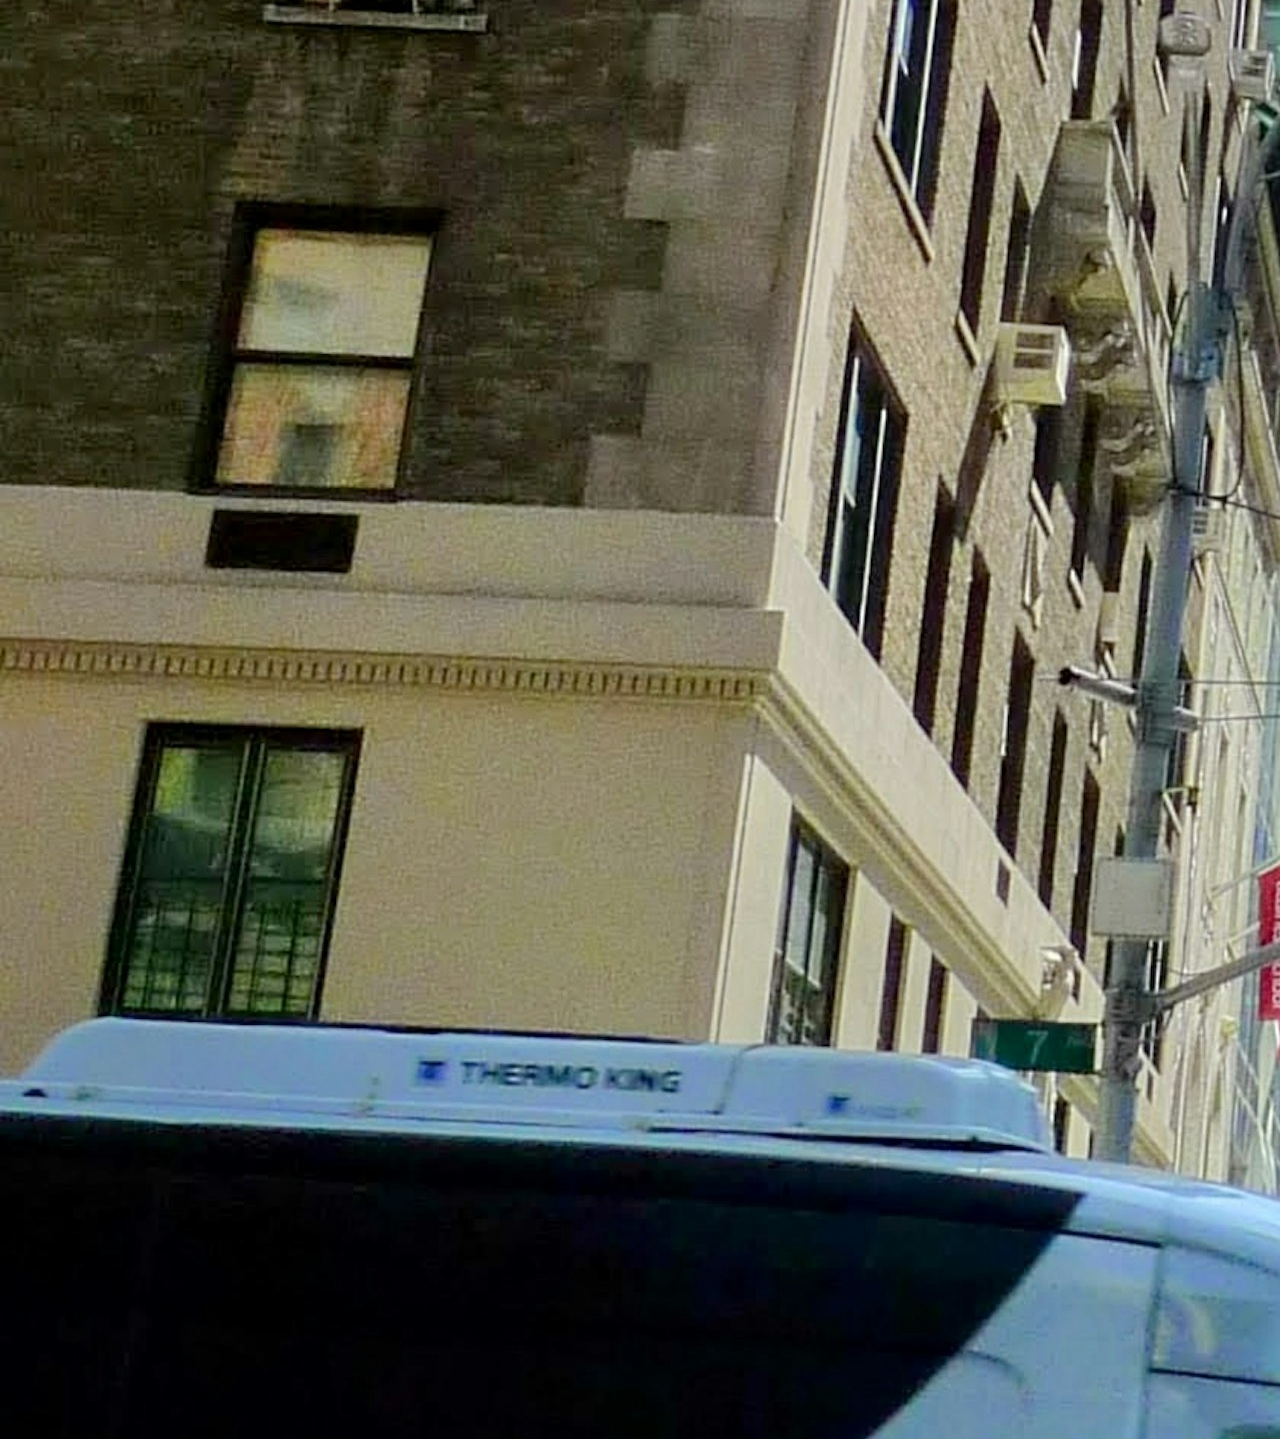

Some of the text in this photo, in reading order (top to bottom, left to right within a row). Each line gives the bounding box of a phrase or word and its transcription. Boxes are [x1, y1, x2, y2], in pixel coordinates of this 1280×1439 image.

[1026, 1028, 1049, 1066] 7
[461, 1060, 681, 1094] THERMO KING
